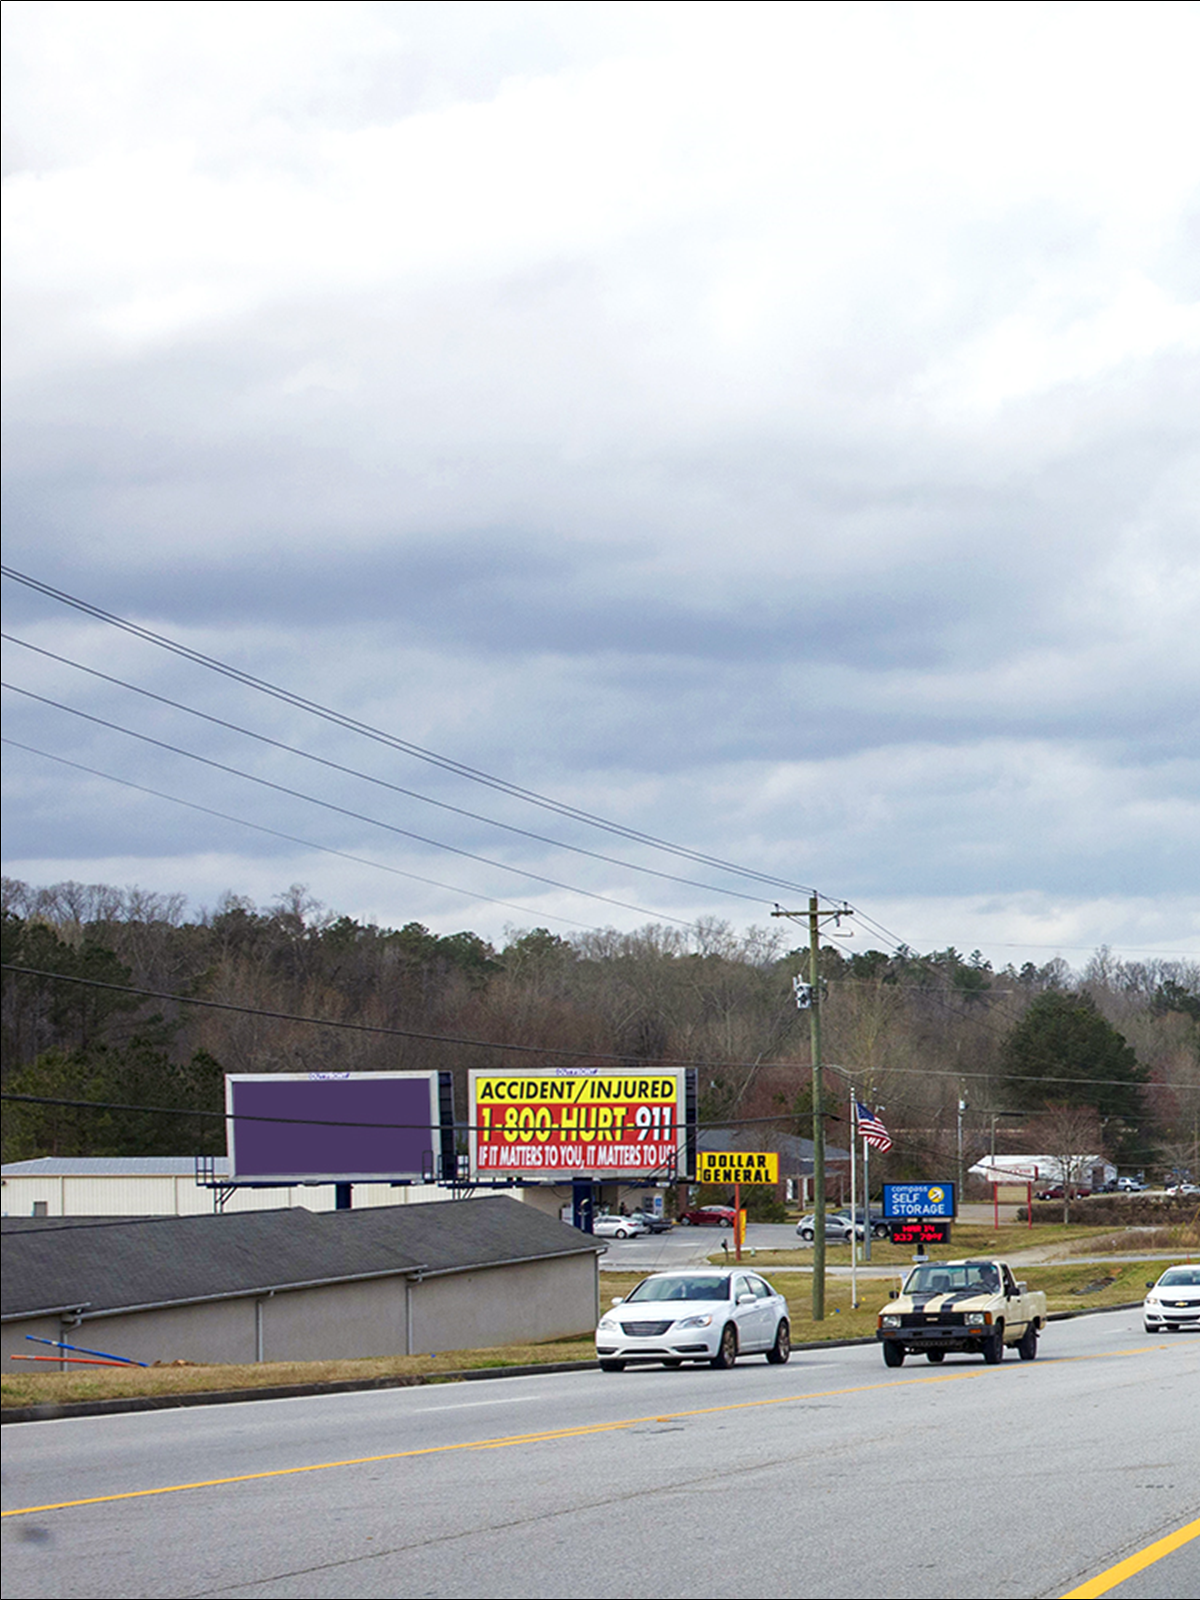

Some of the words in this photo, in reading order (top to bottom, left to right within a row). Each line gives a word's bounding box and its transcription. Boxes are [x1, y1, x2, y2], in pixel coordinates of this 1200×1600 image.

[480, 1079, 674, 1103] ACCIDENT/INJURED
[482, 1105, 673, 1142] 1-800-HURT-911
[479, 1145, 488, 1166] IF
[489, 1145, 498, 1166] IT
[499, 1145, 543, 1166] MATTERS
[545, 1145, 558, 1166] TO
[560, 1145, 585, 1169] YOU,
[587, 1145, 596, 1165] IT
[597, 1145, 641, 1166] MATTERS
[643, 1145, 657, 1166] TO
[707, 1155, 766, 1168] DOLLAR
[703, 1169, 771, 1182] GENERAL
[892, 1193, 920, 1203] SELF
[892, 1204, 945, 1215] STORAGE
